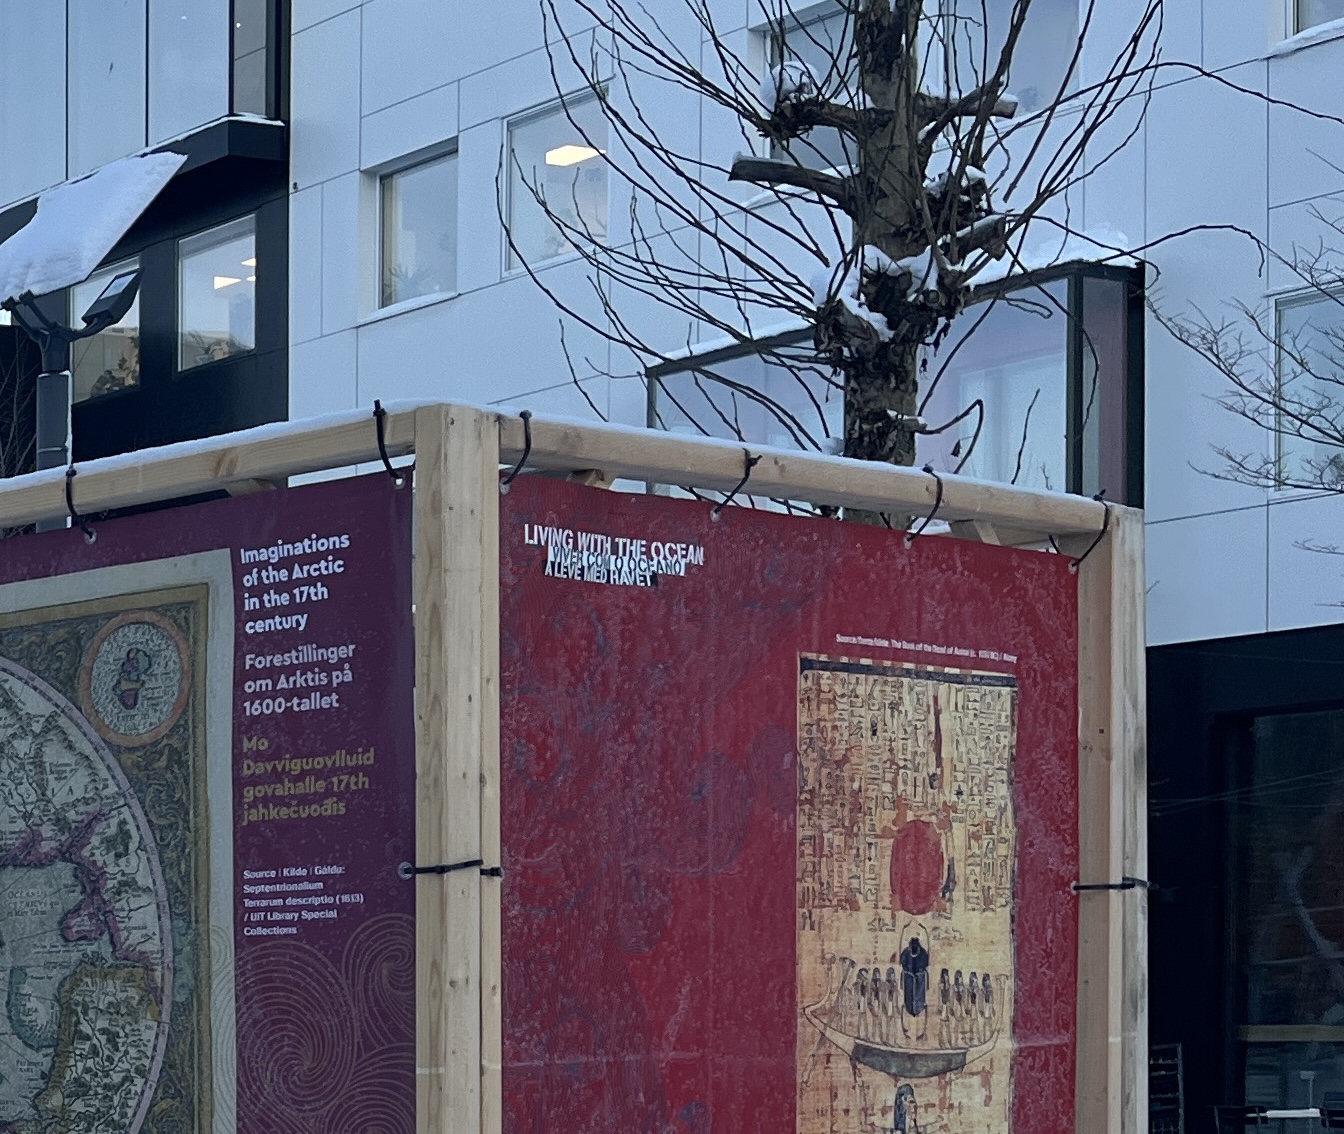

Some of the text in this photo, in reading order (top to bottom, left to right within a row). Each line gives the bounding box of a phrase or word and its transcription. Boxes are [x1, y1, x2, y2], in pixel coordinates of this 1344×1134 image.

[240, 533, 350, 564] Imaginations
[524, 523, 704, 566] LIVING WITH THE OCEAN
[243, 555, 344, 587] of the Arctic
[244, 582, 329, 611] in the 17th
[245, 613, 308, 634] century
[245, 644, 356, 670] Forestillinger
[244, 662, 353, 693] om Arktis på
[243, 692, 339, 716] 1600-tallet
[242, 735, 269, 752] Mo
[242, 747, 375, 777] Davviguovlluid
[243, 772, 370, 801] govahalle 17th
[243, 869, 276, 879] Source
[283, 867, 308, 877] Kilde
[243, 898, 283, 907] Terrarum
[285, 895, 334, 906] descriptio
[267, 908, 338, 921] Library Special
[243, 925, 298, 936] Collections
